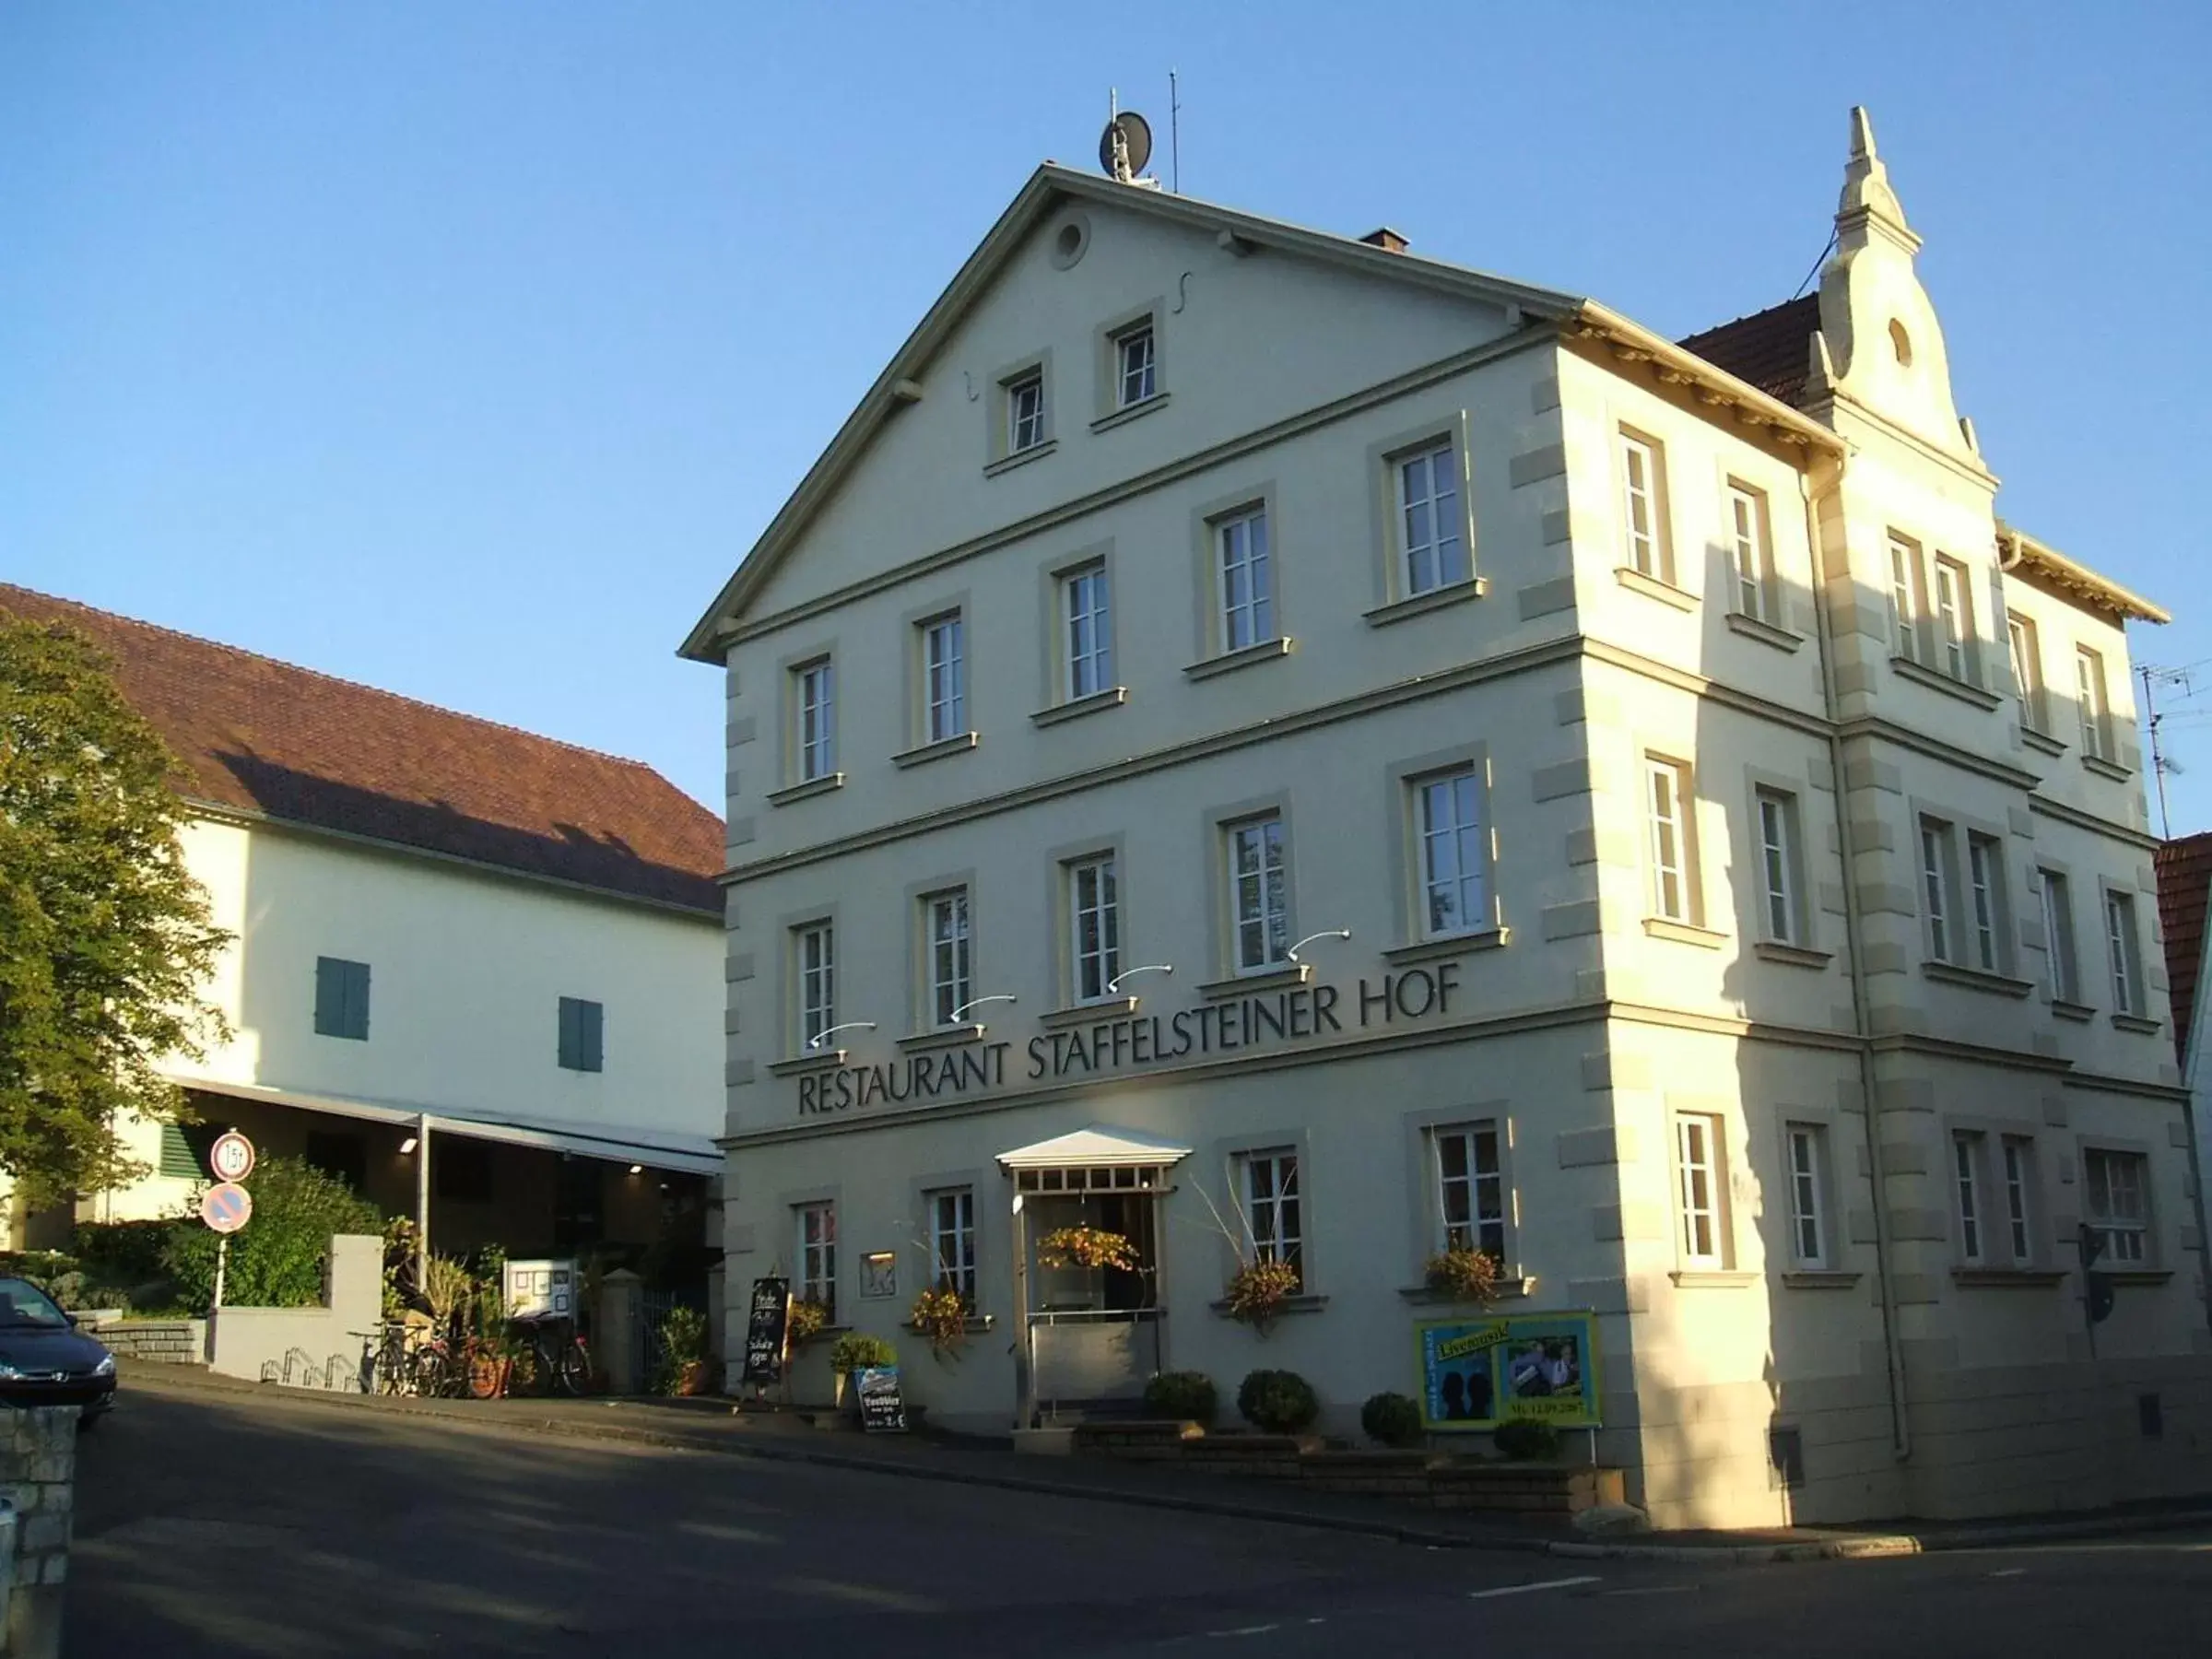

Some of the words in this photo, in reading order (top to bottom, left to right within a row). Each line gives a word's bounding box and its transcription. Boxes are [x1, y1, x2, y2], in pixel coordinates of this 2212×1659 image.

[799, 1041, 1011, 1115] RESTAURANT
[1028, 985, 1342, 1079] STAFFELSTEINER
[1359, 963, 1459, 1026] HOF
